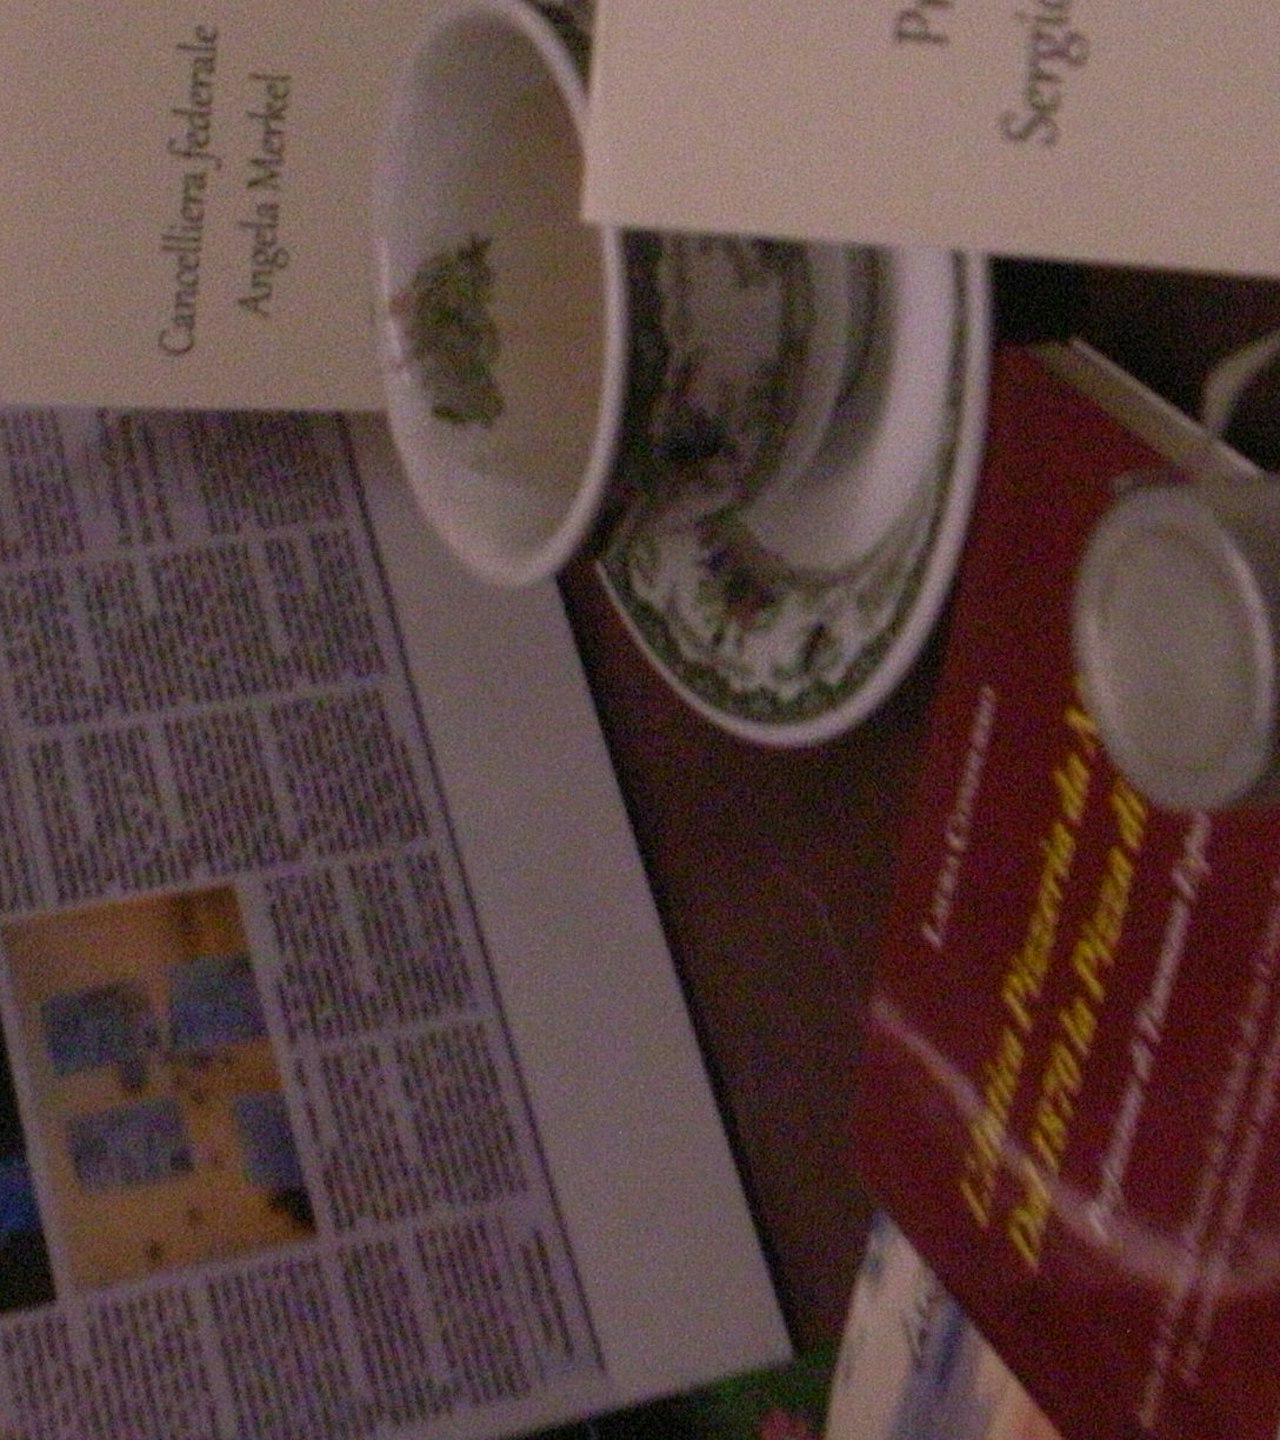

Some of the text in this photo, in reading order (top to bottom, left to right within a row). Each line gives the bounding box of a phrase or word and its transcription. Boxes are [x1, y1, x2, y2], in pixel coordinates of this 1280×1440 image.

[157, 24, 221, 357] Cancelliera federale
[237, 72, 292, 317] Angela Merkel
[1000, 819, 1078, 1033] Pizzeria
[1051, 751, 1092, 827] da
[1069, 844, 1136, 1003] Pizza
[1029, 1040, 1085, 1175] 1870
[1056, 994, 1101, 1059] la
